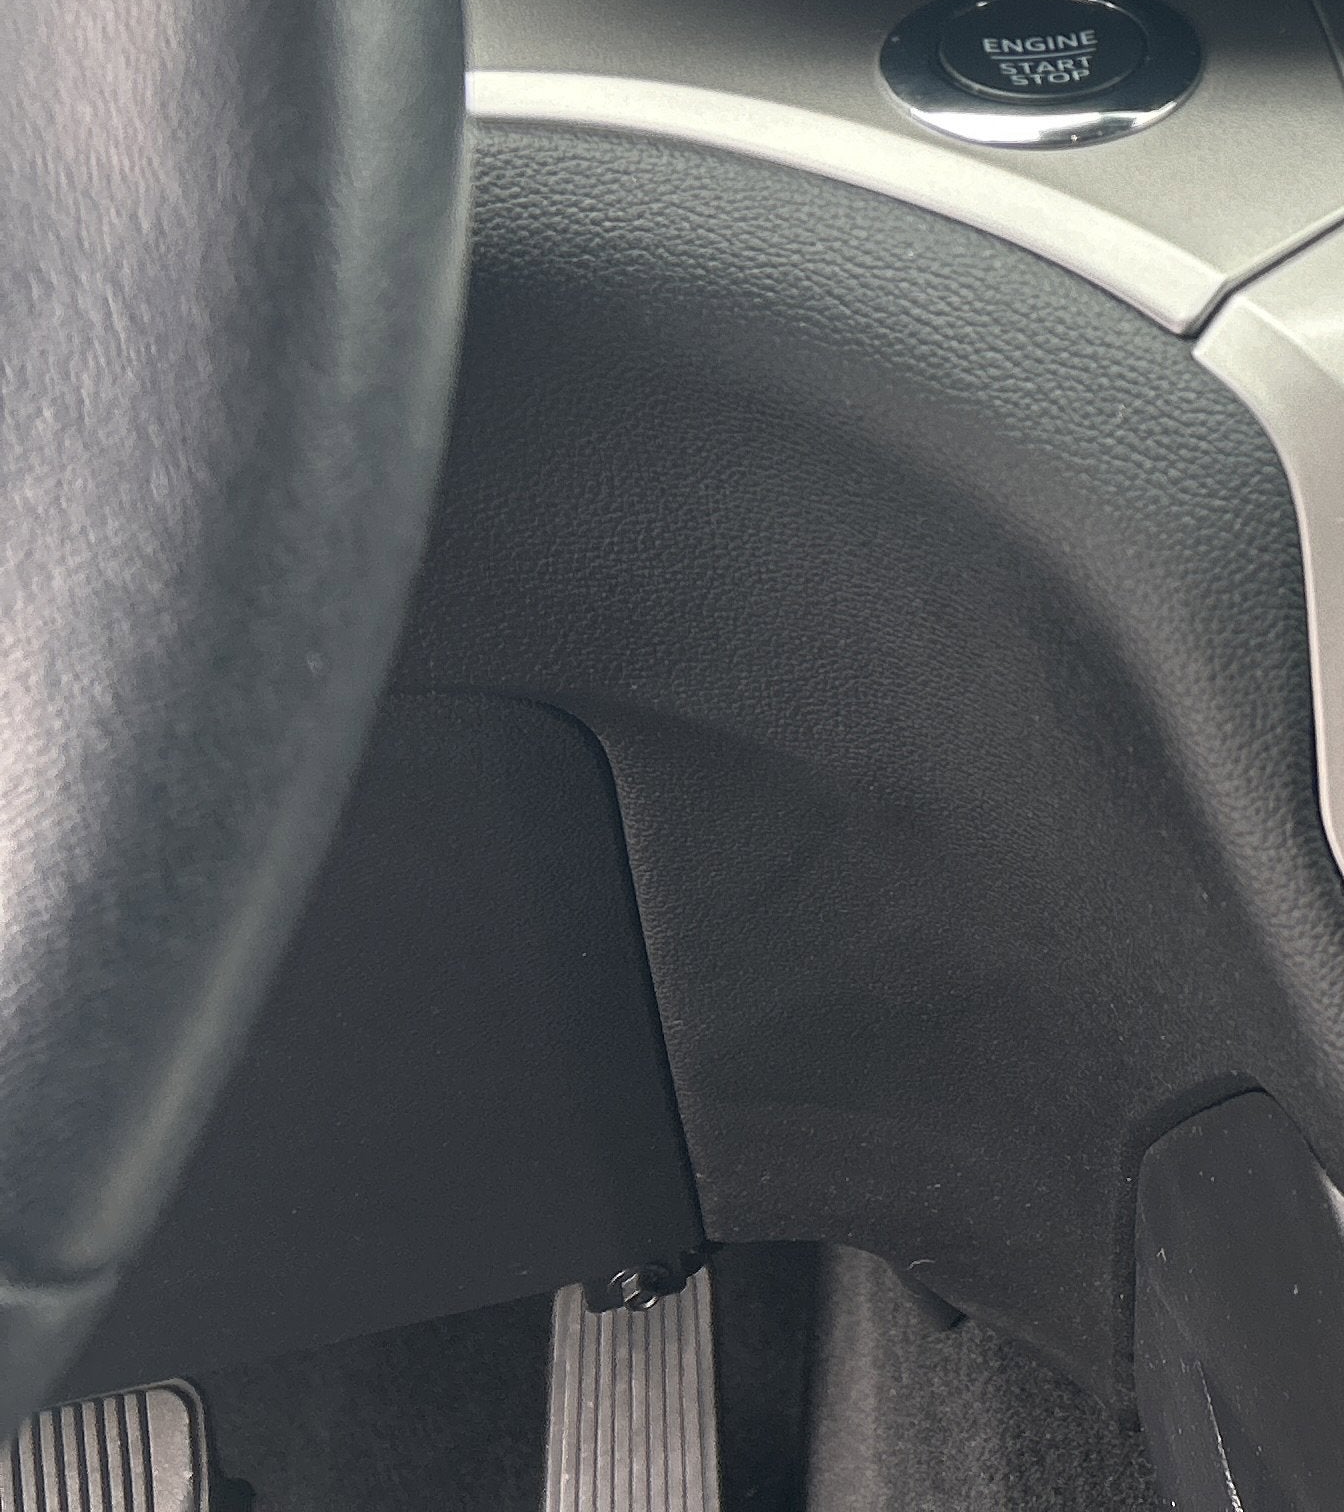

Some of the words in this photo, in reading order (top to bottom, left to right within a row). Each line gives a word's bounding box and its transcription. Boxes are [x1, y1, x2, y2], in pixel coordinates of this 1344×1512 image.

[982, 29, 1099, 54] ENGINE
[999, 56, 1092, 75] START
[1011, 68, 1091, 86] STOP
